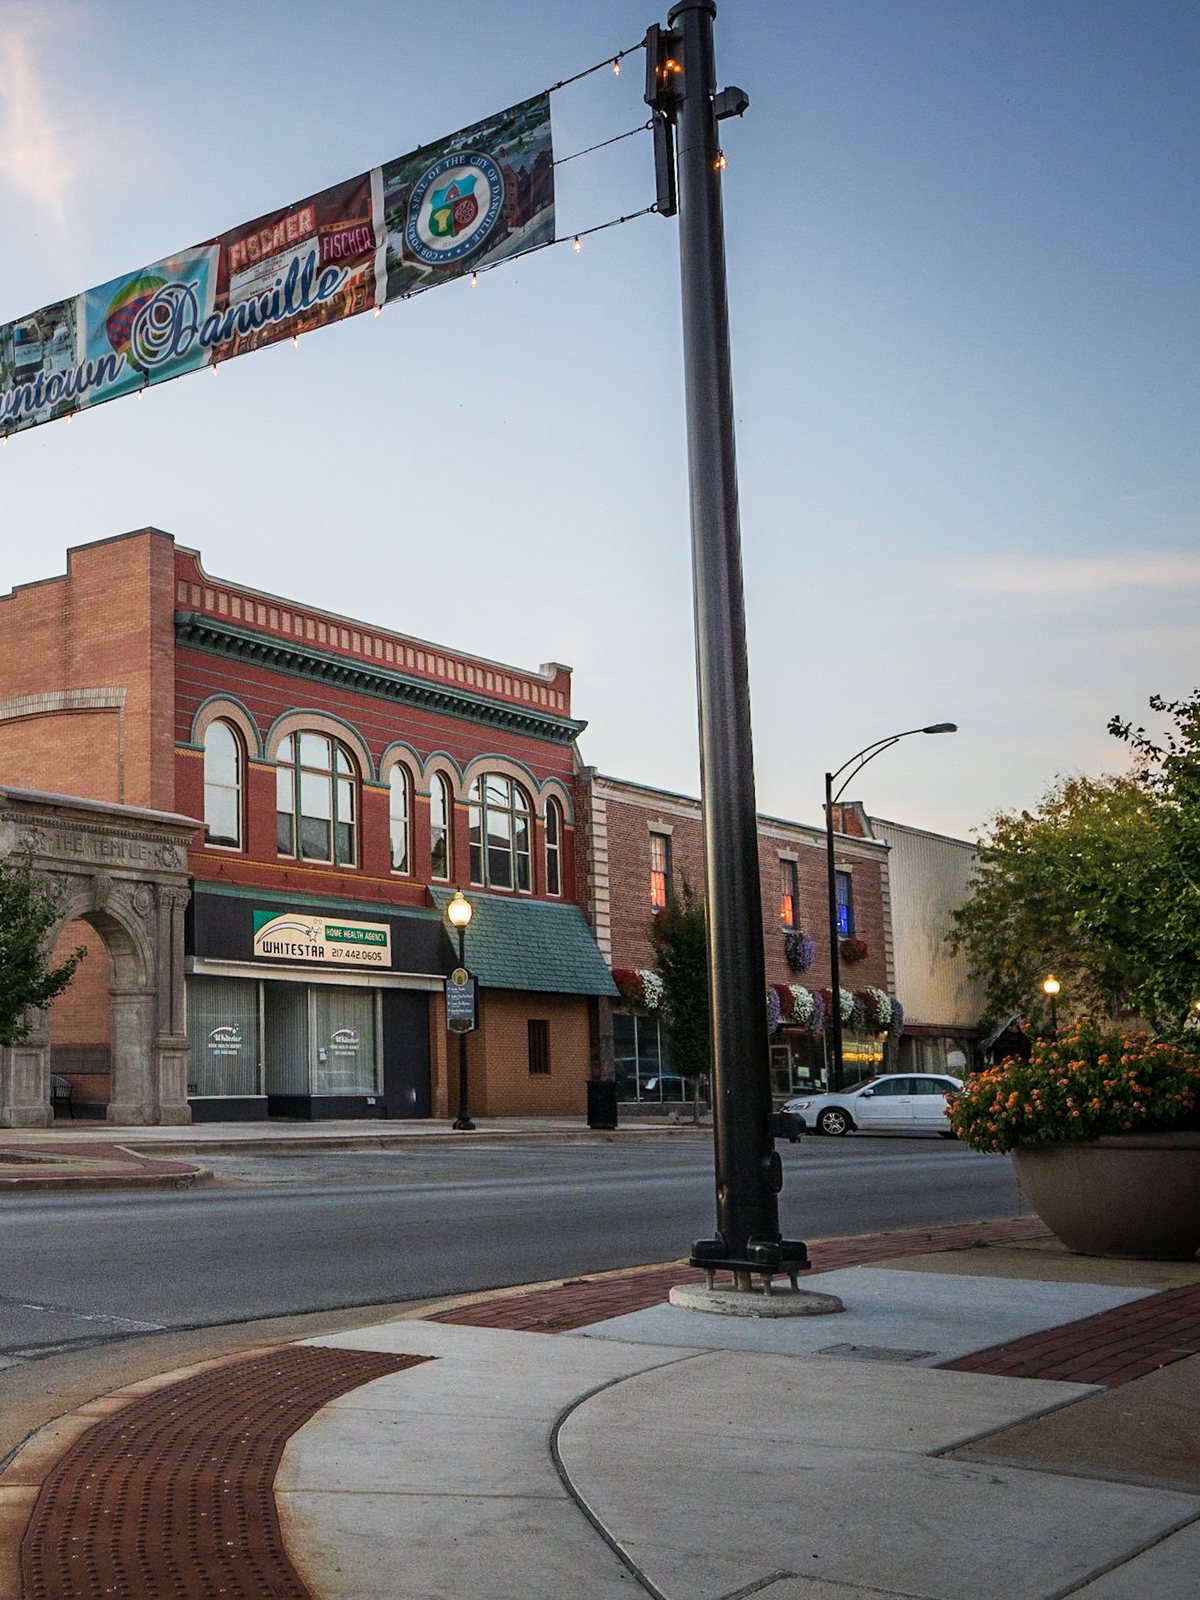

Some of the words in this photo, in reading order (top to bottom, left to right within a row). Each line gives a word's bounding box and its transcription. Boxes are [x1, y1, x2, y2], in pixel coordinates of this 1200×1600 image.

[445, 155, 466, 168] THE
[470, 157, 488, 169] CITY
[428, 167, 441, 180] OF
[488, 168, 498, 182] OF
[412, 182, 428, 209] SEAL
[473, 185, 500, 243] DANVILLE
[230, 208, 314, 271] FISCHER
[323, 226, 372, 261] FISCHER
[132, 249, 350, 368] Danville
[55, 833, 84, 852] THE
[92, 839, 148, 860] TEMPLE
[326, 927, 343, 938] HOME
[344, 929, 364, 940] HEALTH
[365, 931, 385, 942] AGENCY
[262, 941, 325, 958] WHITESTAR
[331, 948, 382, 961] 217.442.0605
